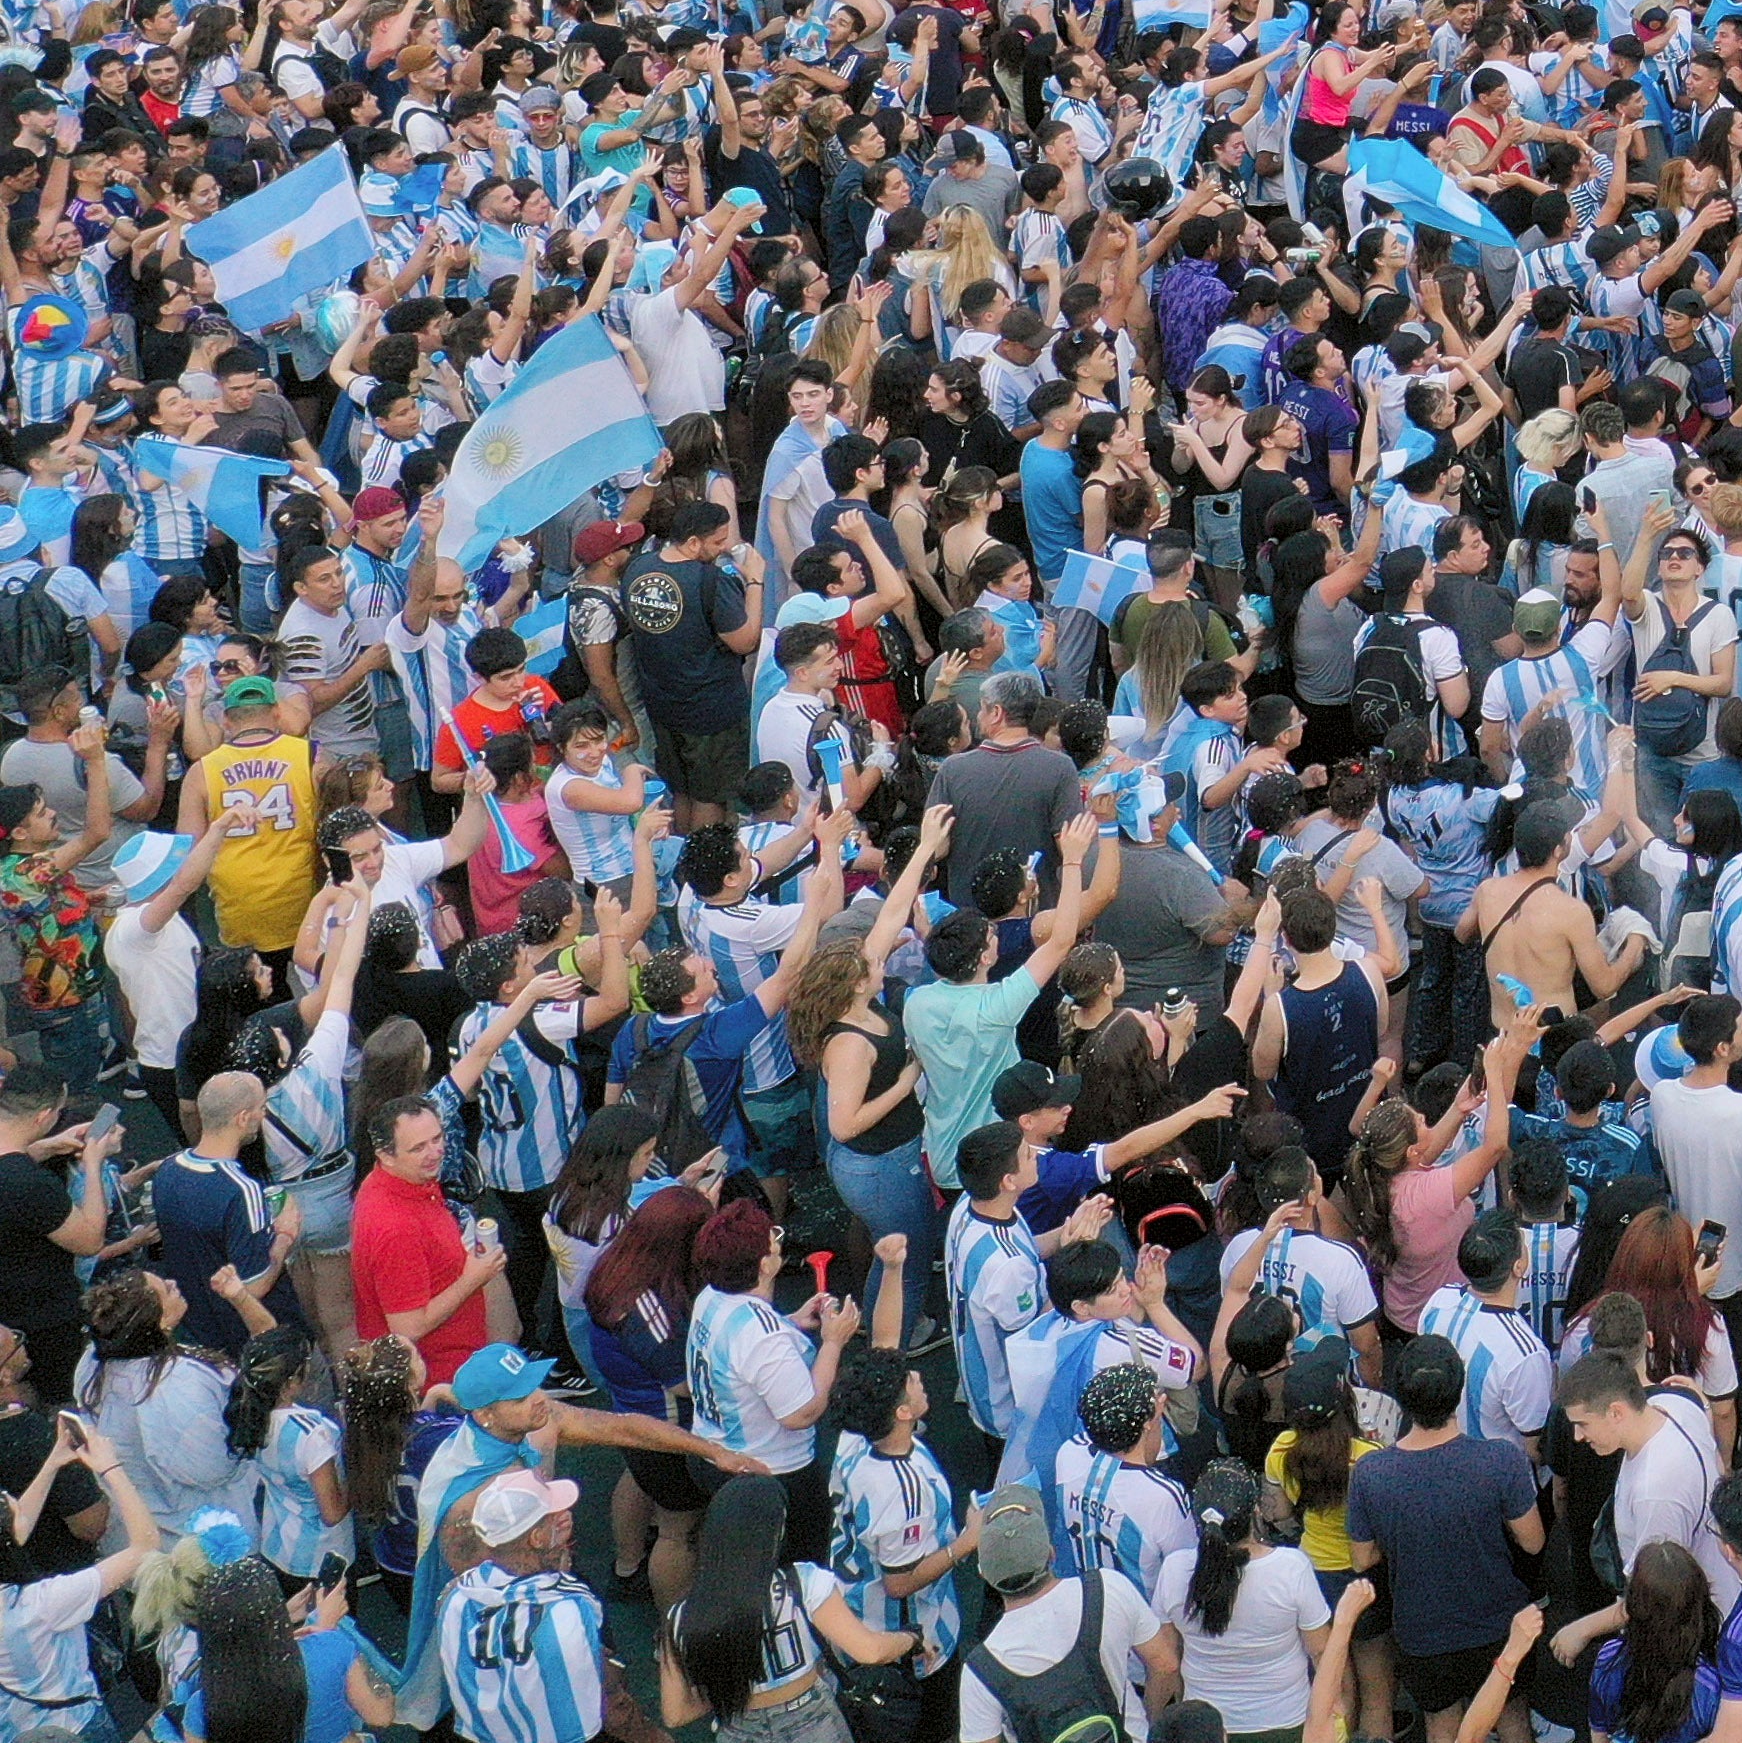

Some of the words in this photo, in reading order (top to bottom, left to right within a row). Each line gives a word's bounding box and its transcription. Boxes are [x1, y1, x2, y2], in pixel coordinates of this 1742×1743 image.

[1395, 120, 1430, 134] MESSI
[220, 760, 288, 787] BRYANT
[1520, 1271, 1567, 1290] MESSI
[1068, 1490, 1113, 1529] MESSI
